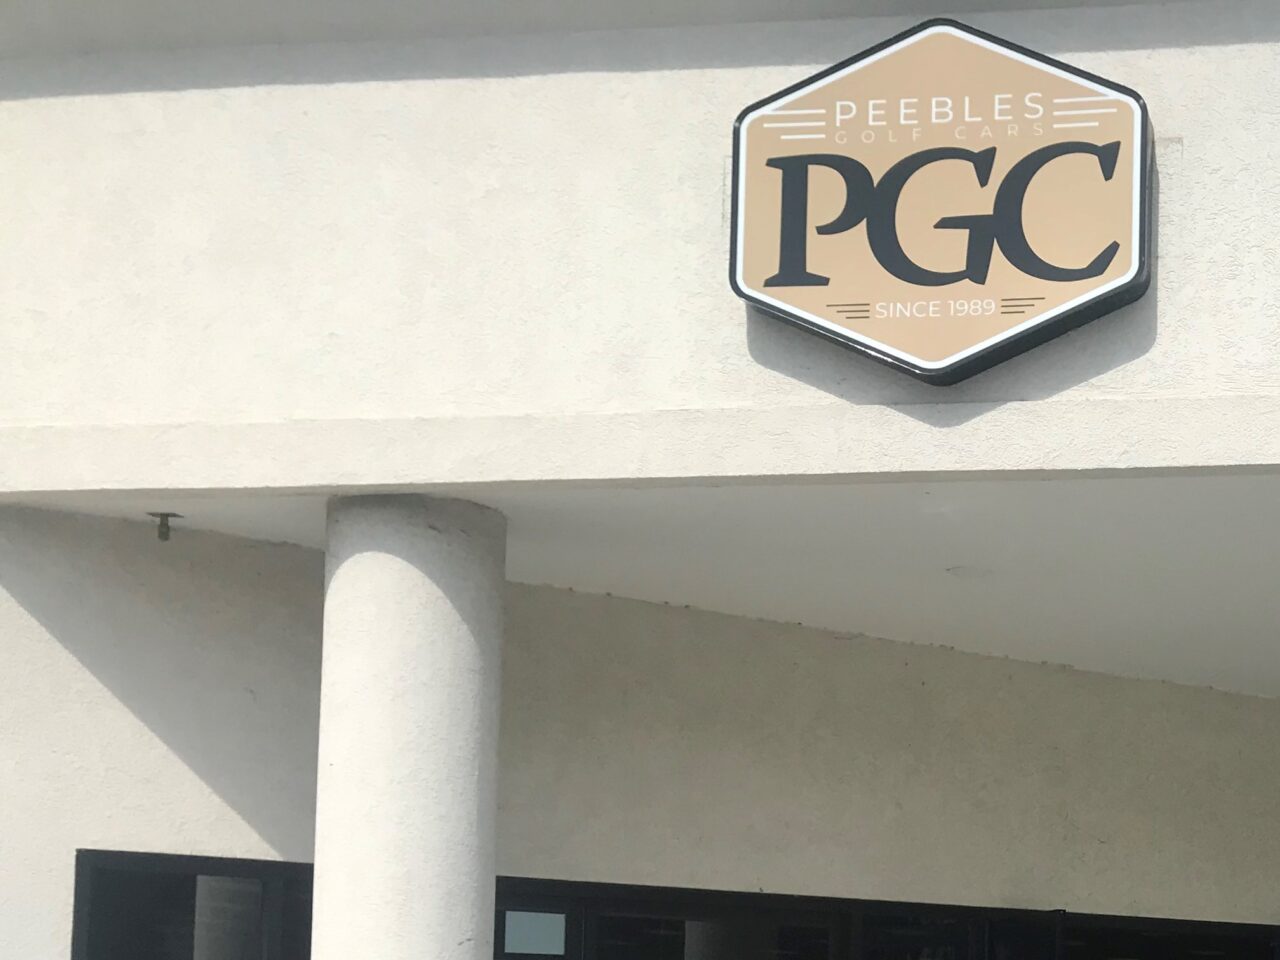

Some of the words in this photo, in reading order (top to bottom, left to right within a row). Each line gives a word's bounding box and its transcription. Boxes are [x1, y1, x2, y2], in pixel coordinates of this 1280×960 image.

[835, 92, 1044, 127] PEEBLES
[834, 127, 922, 144] GOLF
[954, 122, 1044, 140] CARS
[763, 140, 1121, 288] PGC
[874, 301, 941, 319] SINCE
[948, 299, 996, 317] 1989
